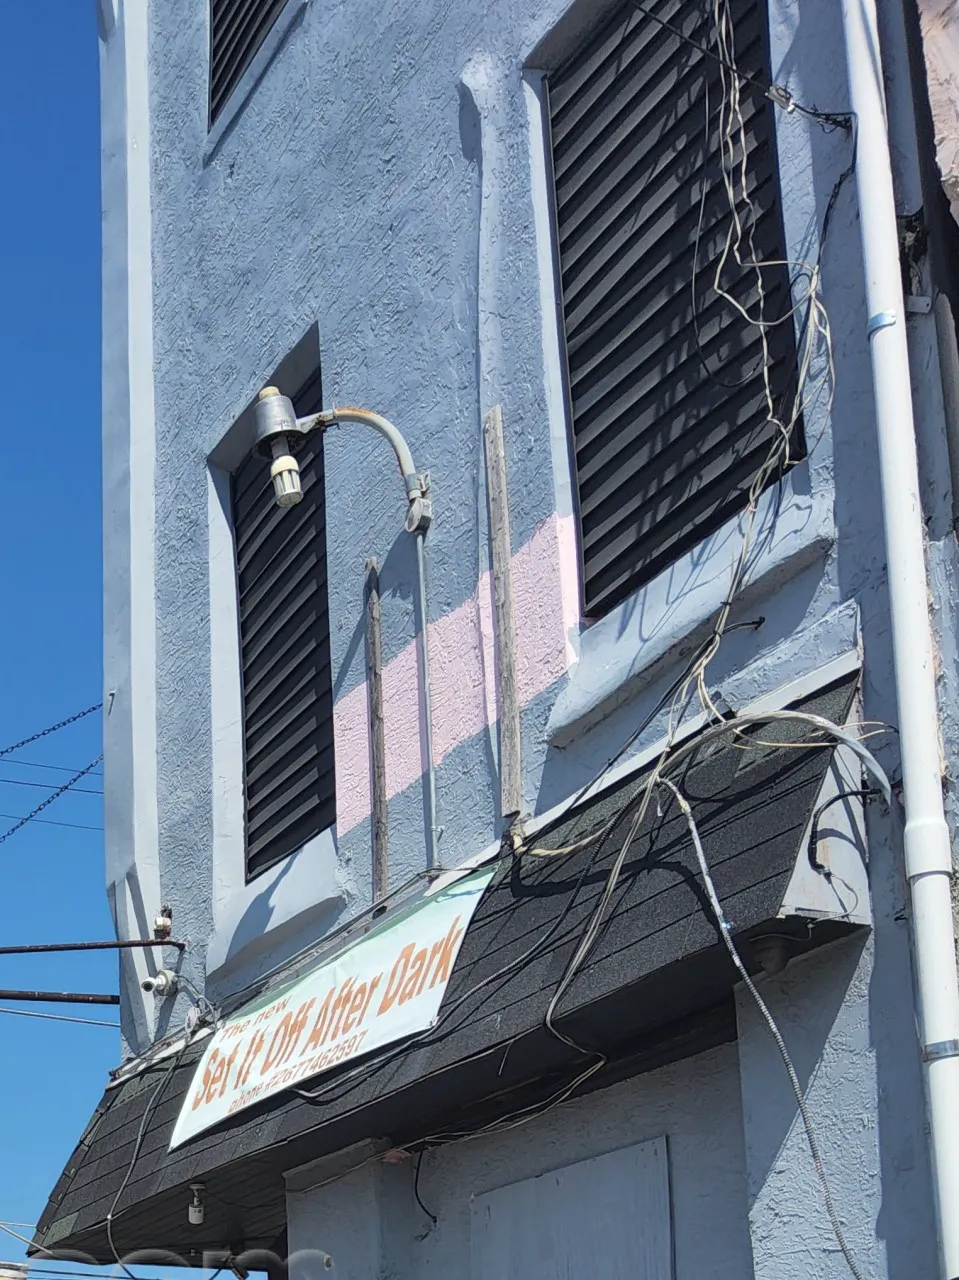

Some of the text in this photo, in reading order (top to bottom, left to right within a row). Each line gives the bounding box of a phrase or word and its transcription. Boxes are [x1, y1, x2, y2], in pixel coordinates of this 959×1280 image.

[192, 914, 465, 1112] Set It Off After Dark
[253, 995, 293, 1026] new
